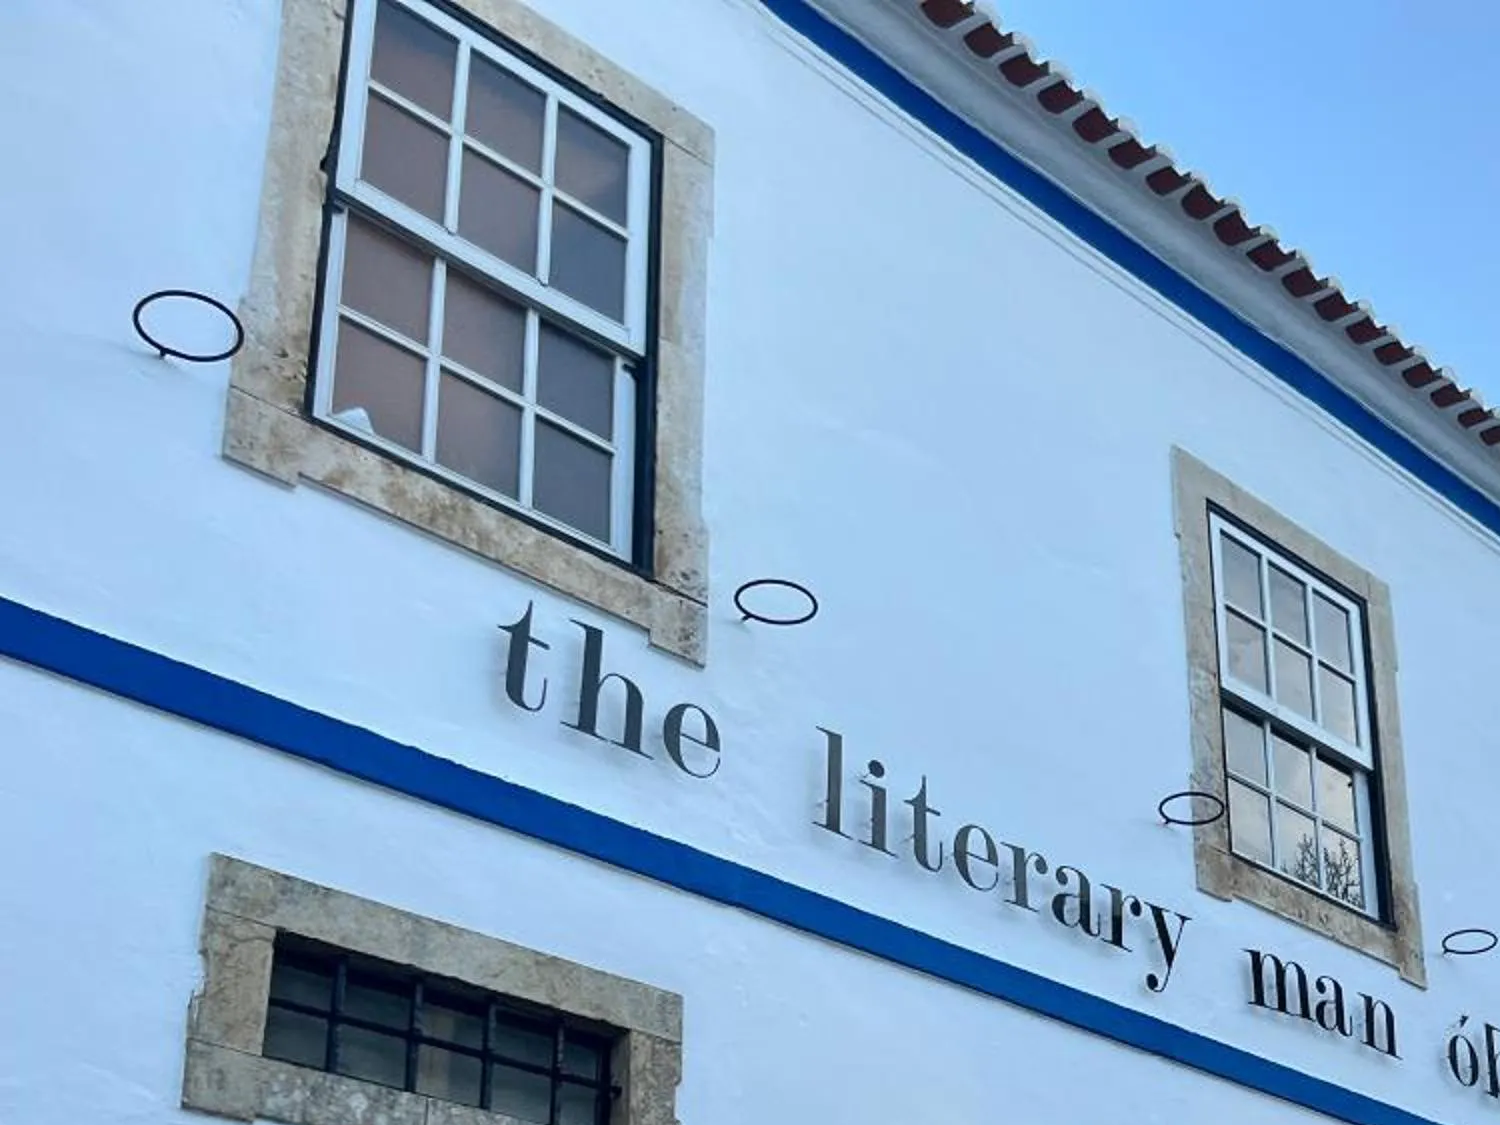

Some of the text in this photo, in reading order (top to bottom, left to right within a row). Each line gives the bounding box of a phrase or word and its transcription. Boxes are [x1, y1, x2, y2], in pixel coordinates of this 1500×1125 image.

[498, 600, 721, 778] the
[812, 725, 1193, 993] literary
[1246, 948, 1402, 1060] man
